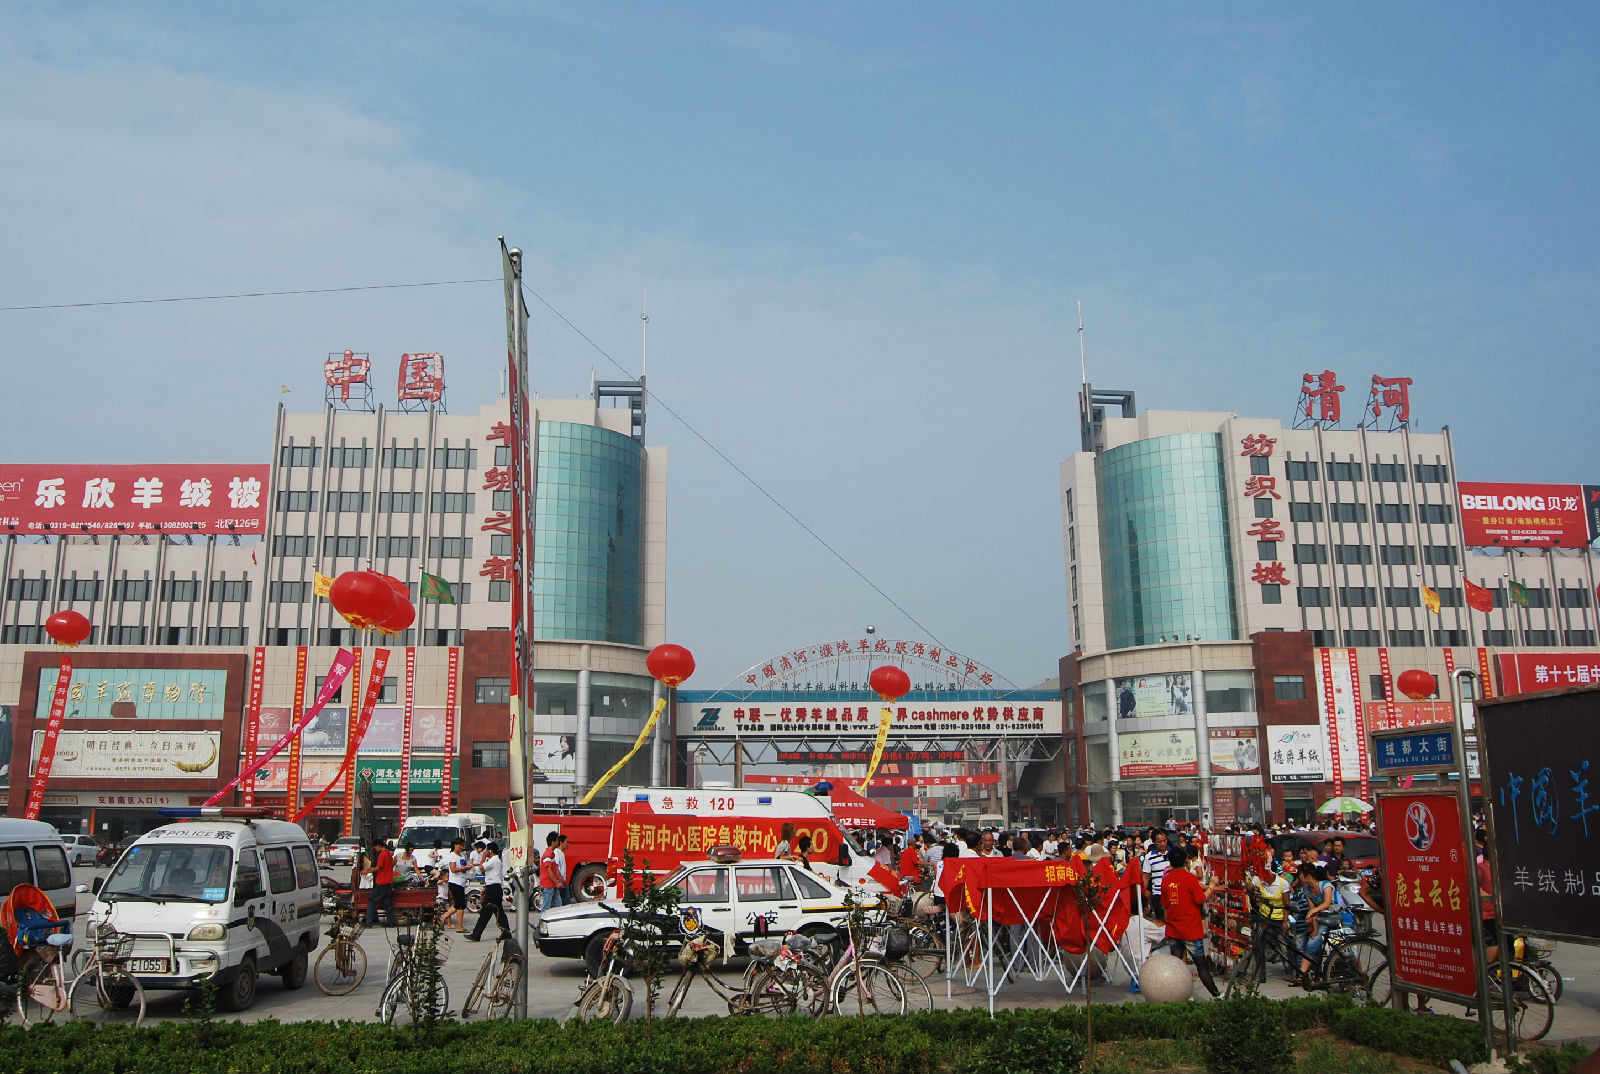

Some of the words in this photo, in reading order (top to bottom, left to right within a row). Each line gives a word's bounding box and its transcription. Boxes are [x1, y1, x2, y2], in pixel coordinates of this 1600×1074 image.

[324, 350, 444, 403] 中国
[1302, 370, 1413, 422] 清河
[34, 477, 262, 509] 乐欣羊绒被
[1461, 494, 1545, 511] BEILONG
[1547, 496, 1578, 511] 贝龙
[1240, 433, 1291, 586] 纺织名城
[1534, 664, 1600, 684] 第十七届中
[47, 681, 204, 704] 国羊绒博物馆
[911, 709, 970, 722] cashmere
[973, 706, 1044, 722] 优势供应商
[1385, 736, 1447, 756] 绒都大街
[662, 796, 698, 810] 急救
[709, 797, 735, 811] 120
[167, 830, 214, 838] POLICE
[626, 821, 778, 853] 清河中心医院急救中心
[1395, 872, 1461, 911] 鹿王云台
[280, 903, 296, 924] 公安
[746, 910, 779, 925] 公安
